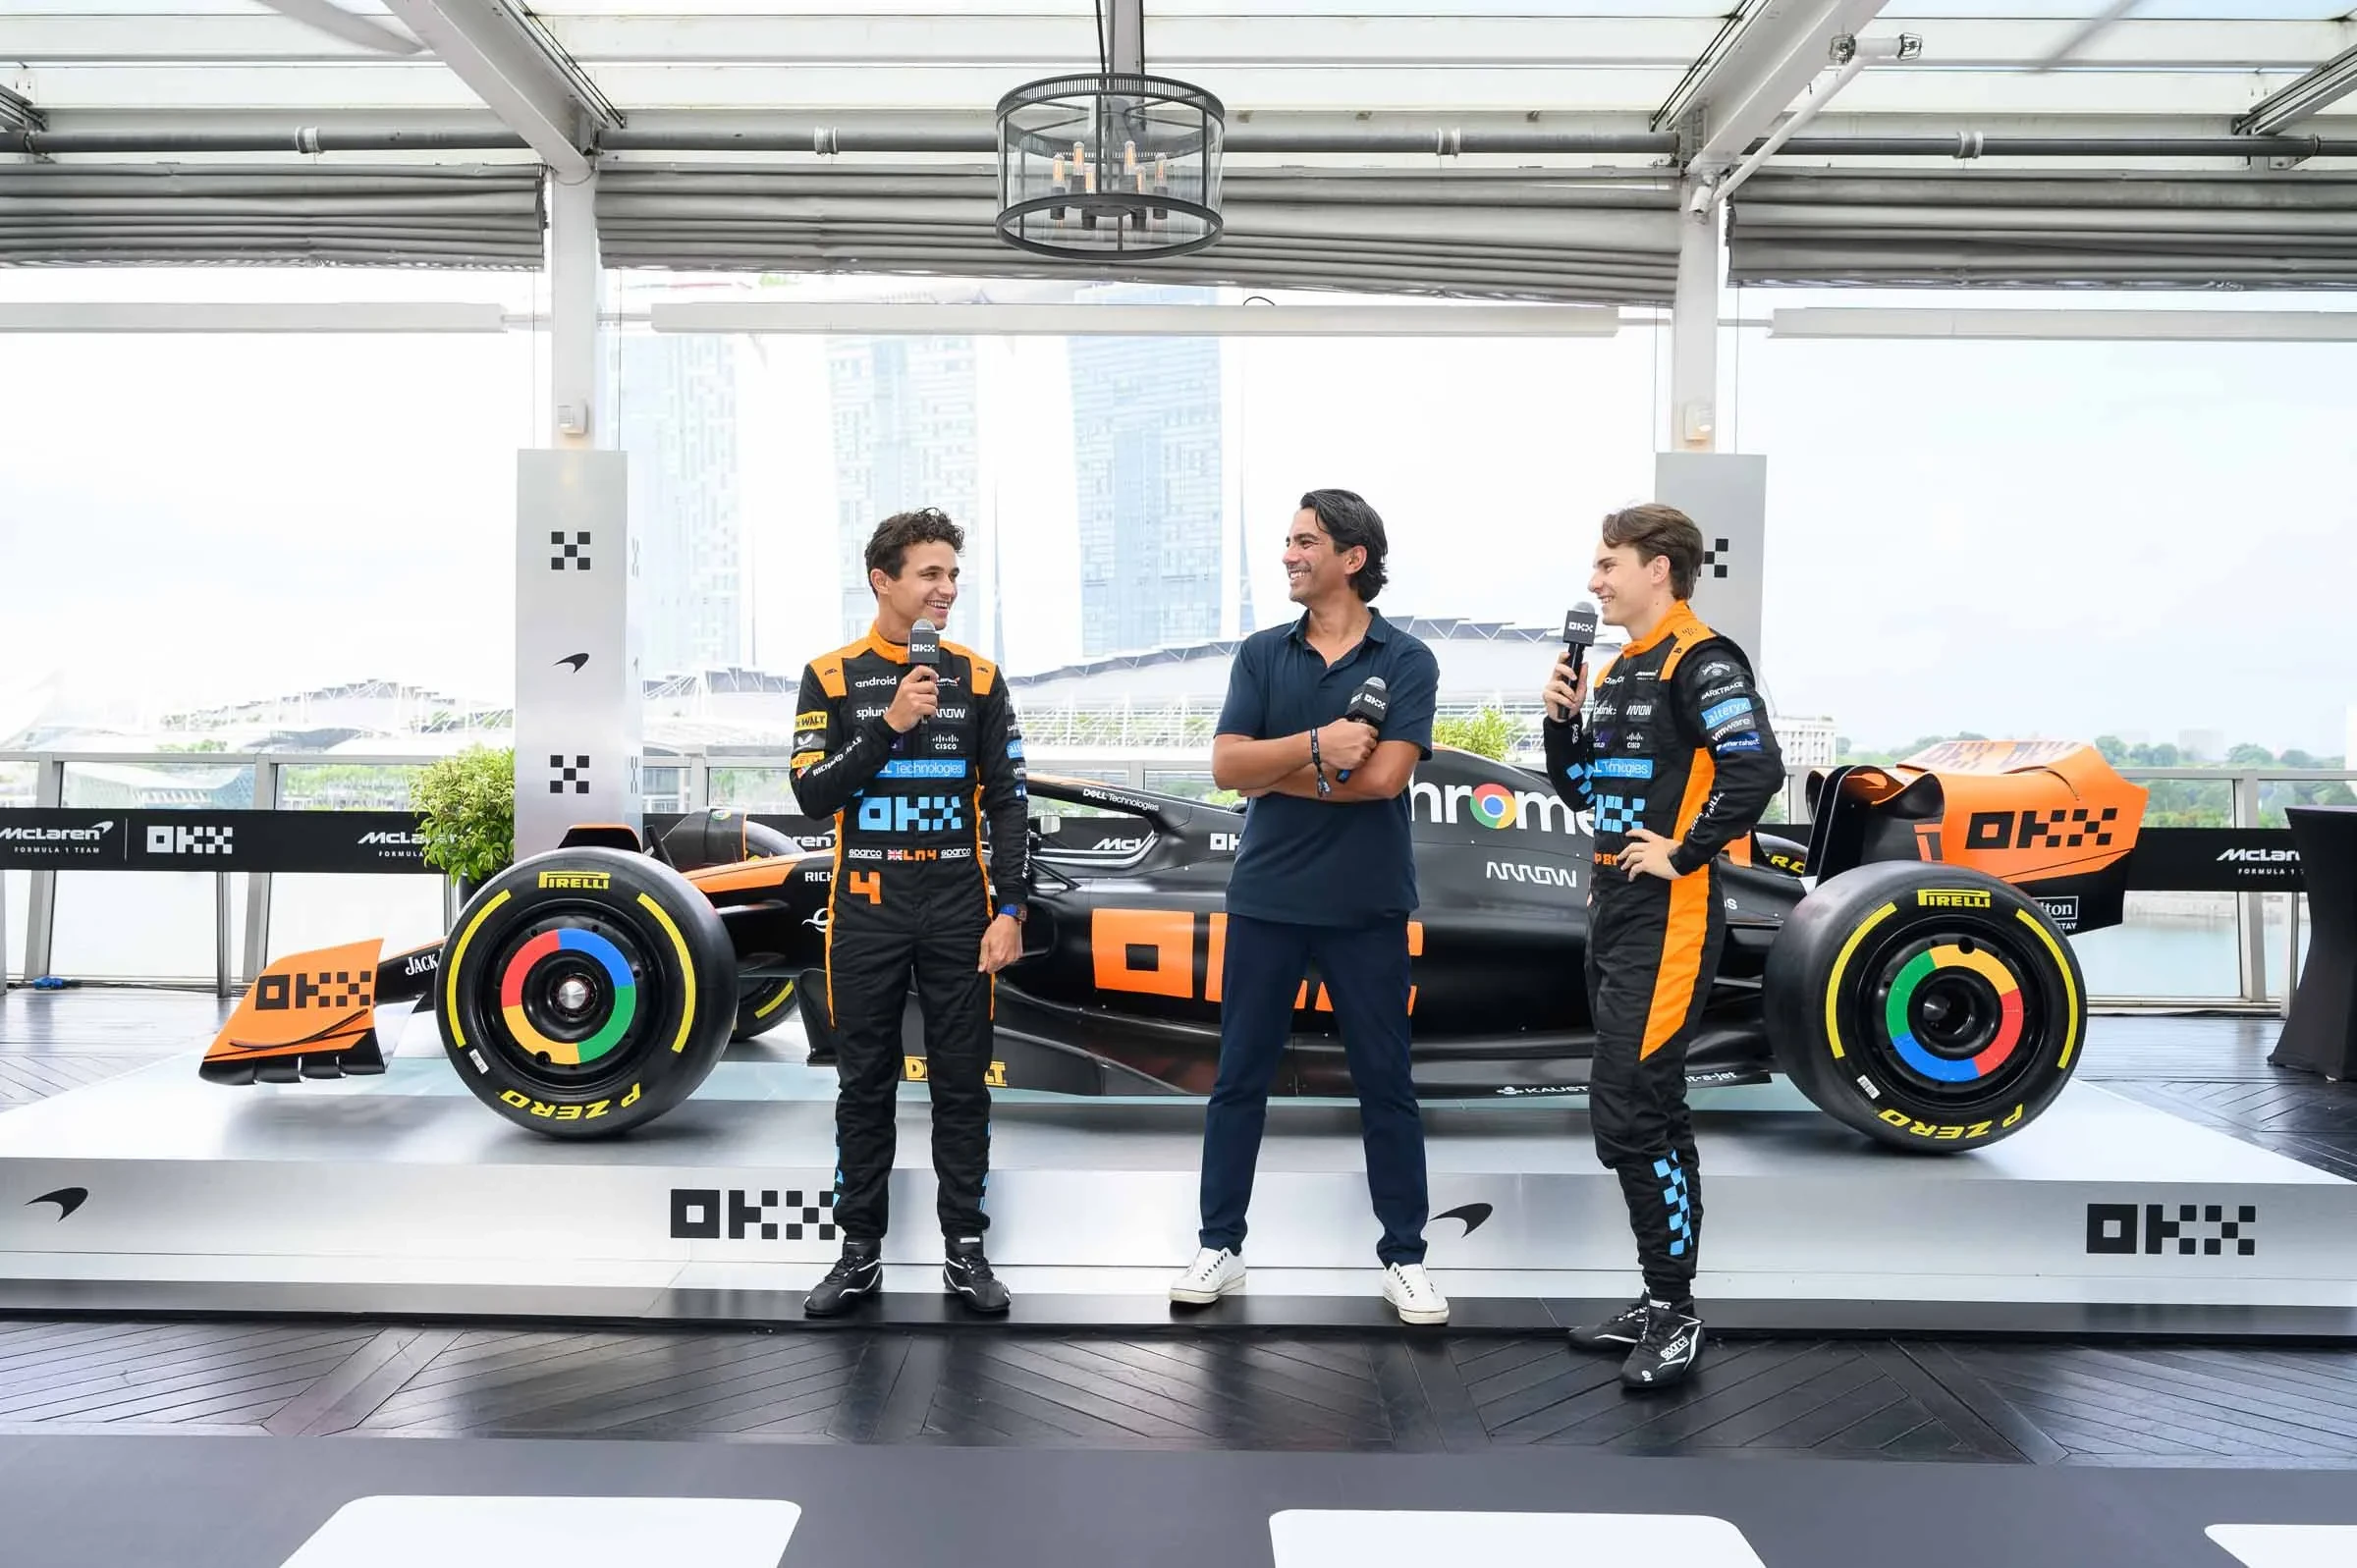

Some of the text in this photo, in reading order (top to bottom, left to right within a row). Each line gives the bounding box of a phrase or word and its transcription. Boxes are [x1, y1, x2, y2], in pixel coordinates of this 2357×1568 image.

[1568, 622, 1594, 632] OKX
[911, 643, 935, 653] OKX
[855, 676, 897, 688] android
[1364, 693, 1386, 710] OKX
[895, 762, 962, 777] Technologies
[1082, 787, 1160, 812] DELL Technologies
[858, 796, 962, 832] OKX
[0, 828, 100, 840] McLaren
[147, 826, 234, 854] OKX
[1965, 807, 2118, 849] OKX
[849, 848, 883, 859] sparco
[2216, 848, 2300, 861] McLar
[538, 871, 611, 890] PIRELLI
[1486, 860, 1577, 889] ARROW
[850, 871, 881, 904] 4
[1917, 889, 1991, 908] PIRELLI
[405, 953, 439, 976] JACK
[255, 970, 371, 1010] OKX
[499, 1083, 641, 1120] P ZERO
[1878, 1103, 2024, 1140] P ZERO
[670, 1188, 836, 1240] OKX
[2086, 1204, 2256, 1256] OKX
